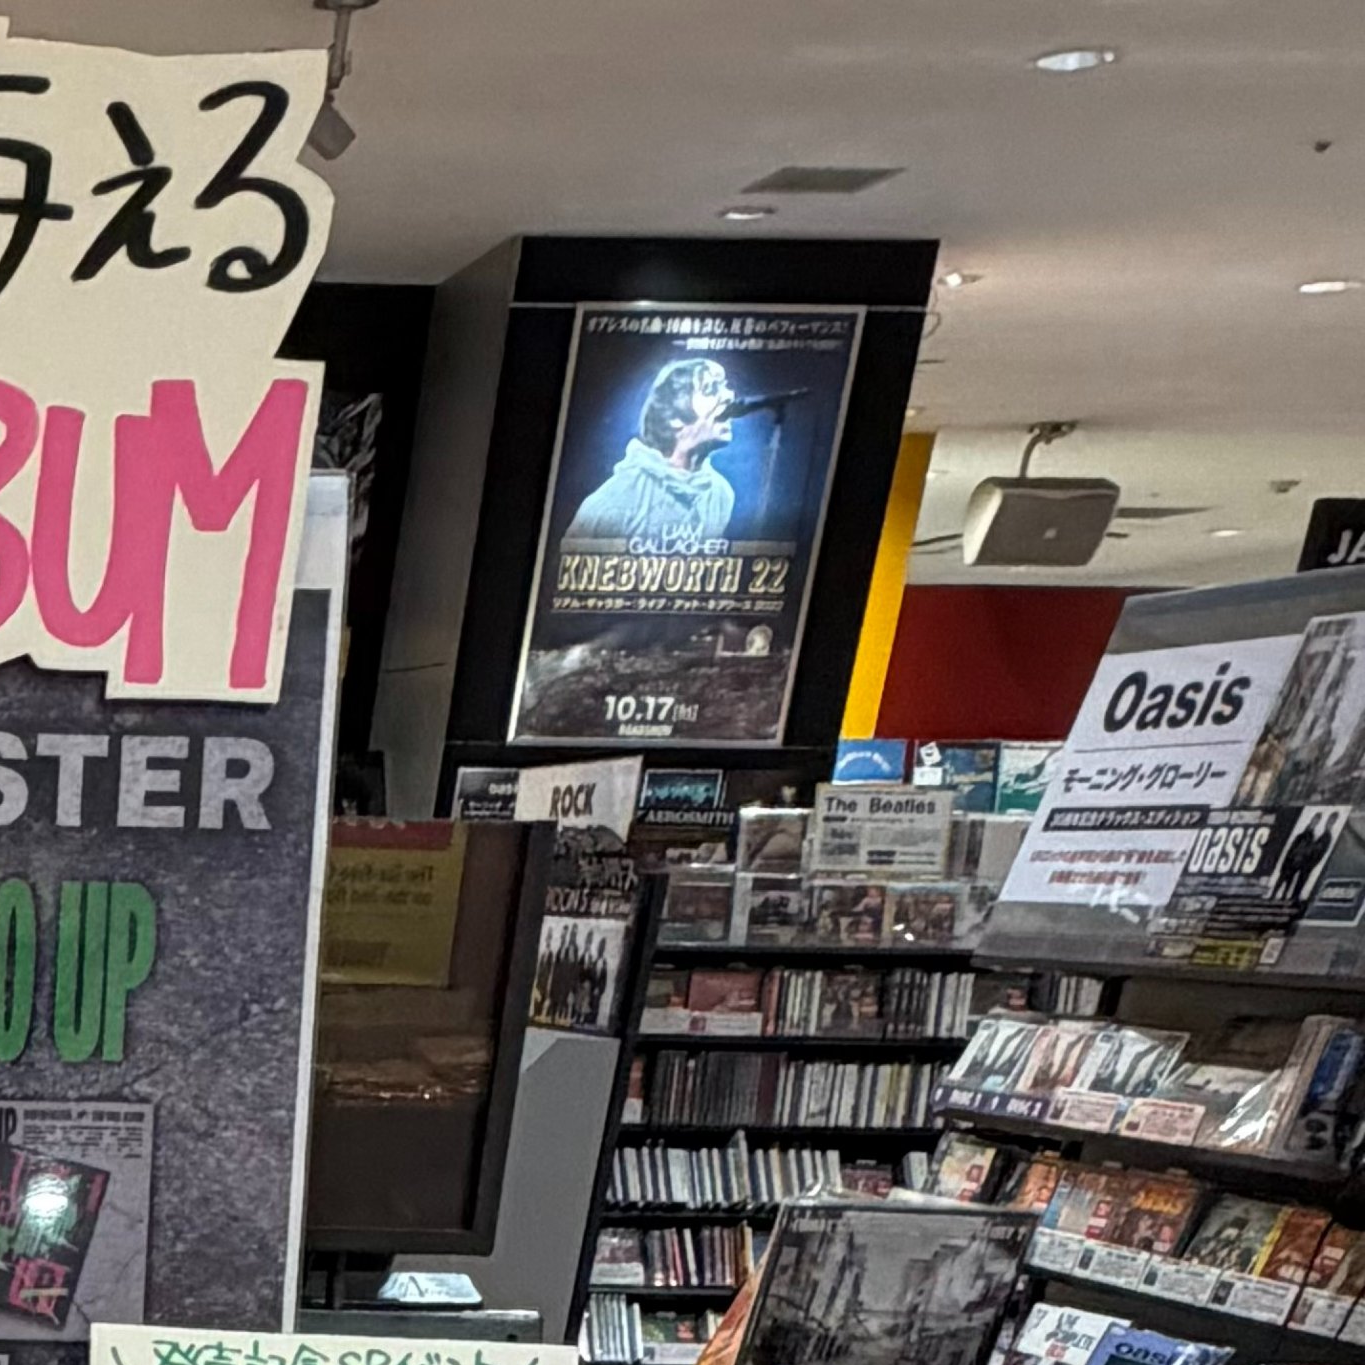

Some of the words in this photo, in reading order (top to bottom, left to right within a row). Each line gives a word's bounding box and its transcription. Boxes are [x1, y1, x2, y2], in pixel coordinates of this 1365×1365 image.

[629, 538, 729, 555] GALLAGHER
[557, 555, 743, 592] KNEBWORTH
[748, 557, 789, 593] 22
[604, 695, 675, 720] 10.17
[1104, 661, 1252, 733] Oasis
[1063, 760, 1228, 793] モーニング・グローリー
[549, 783, 596, 818] ROCK
[825, 797, 858, 813] The
[869, 797, 936, 814] Beatles
[644, 810, 735, 826] AEROSMITH
[55, 880, 157, 1064] UP
